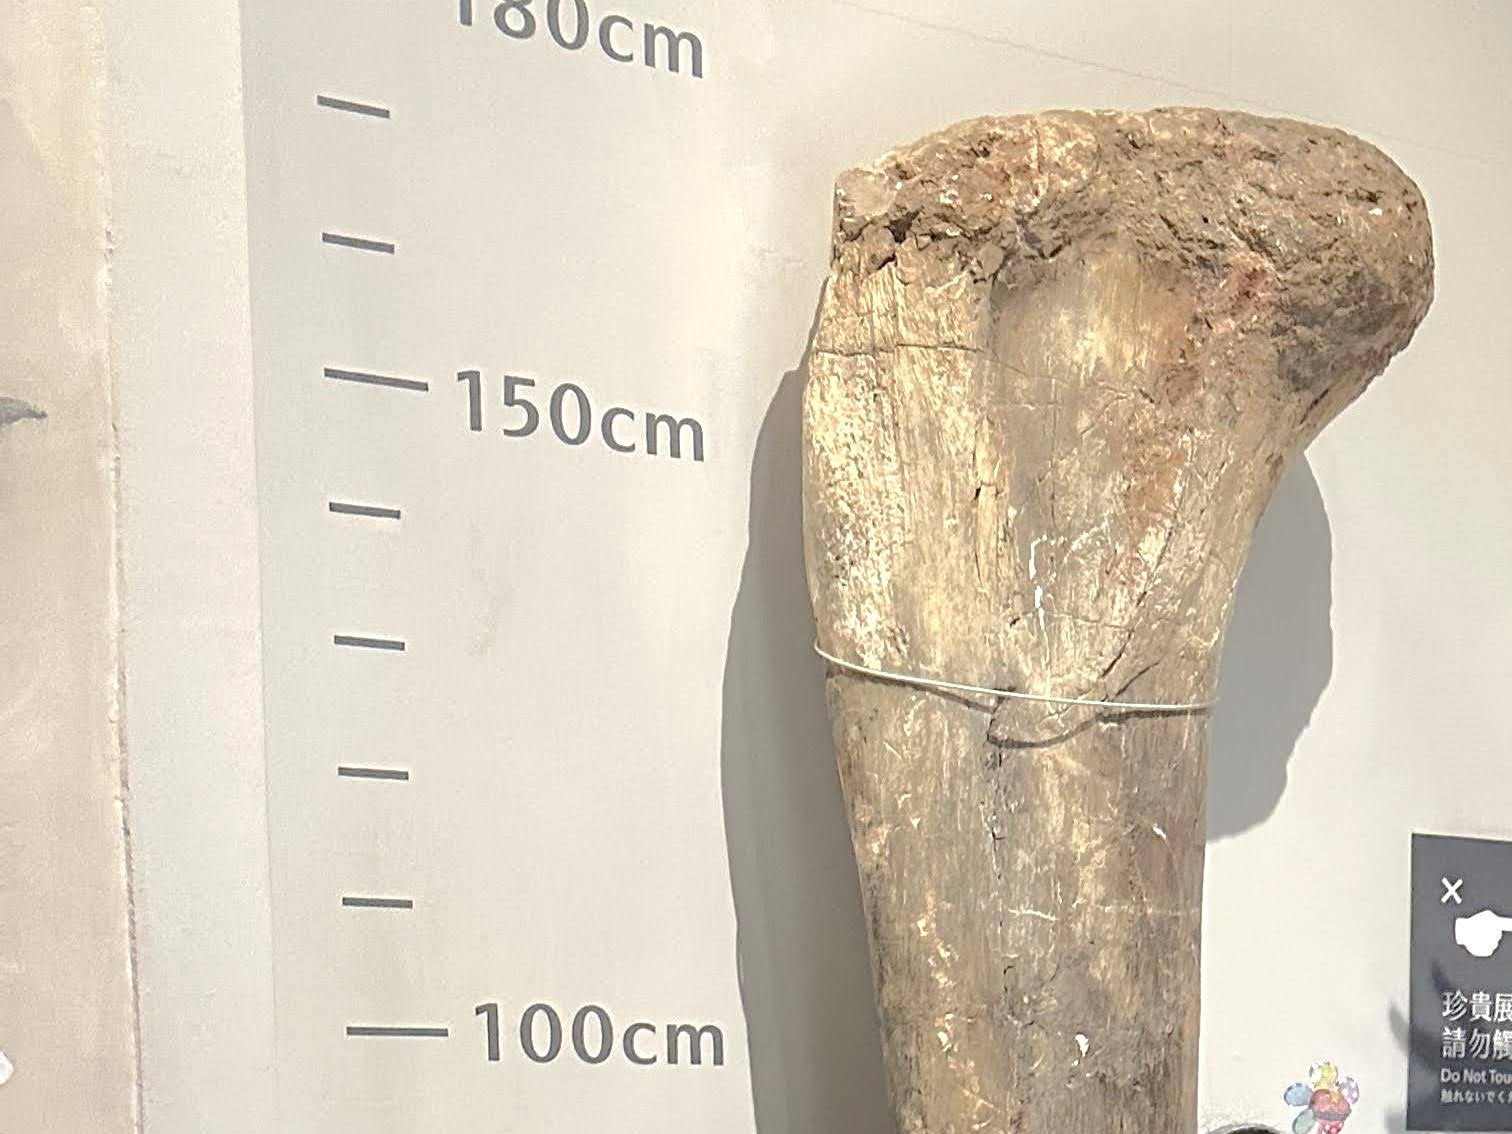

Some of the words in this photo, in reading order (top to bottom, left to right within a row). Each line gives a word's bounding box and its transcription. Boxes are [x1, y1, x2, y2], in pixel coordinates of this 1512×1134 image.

[457, 369, 705, 462] 150cm
[474, 1002, 724, 1066] 100cm
[1440, 1067, 1460, 1083] Do
[1463, 1068, 1487, 1083] Not
